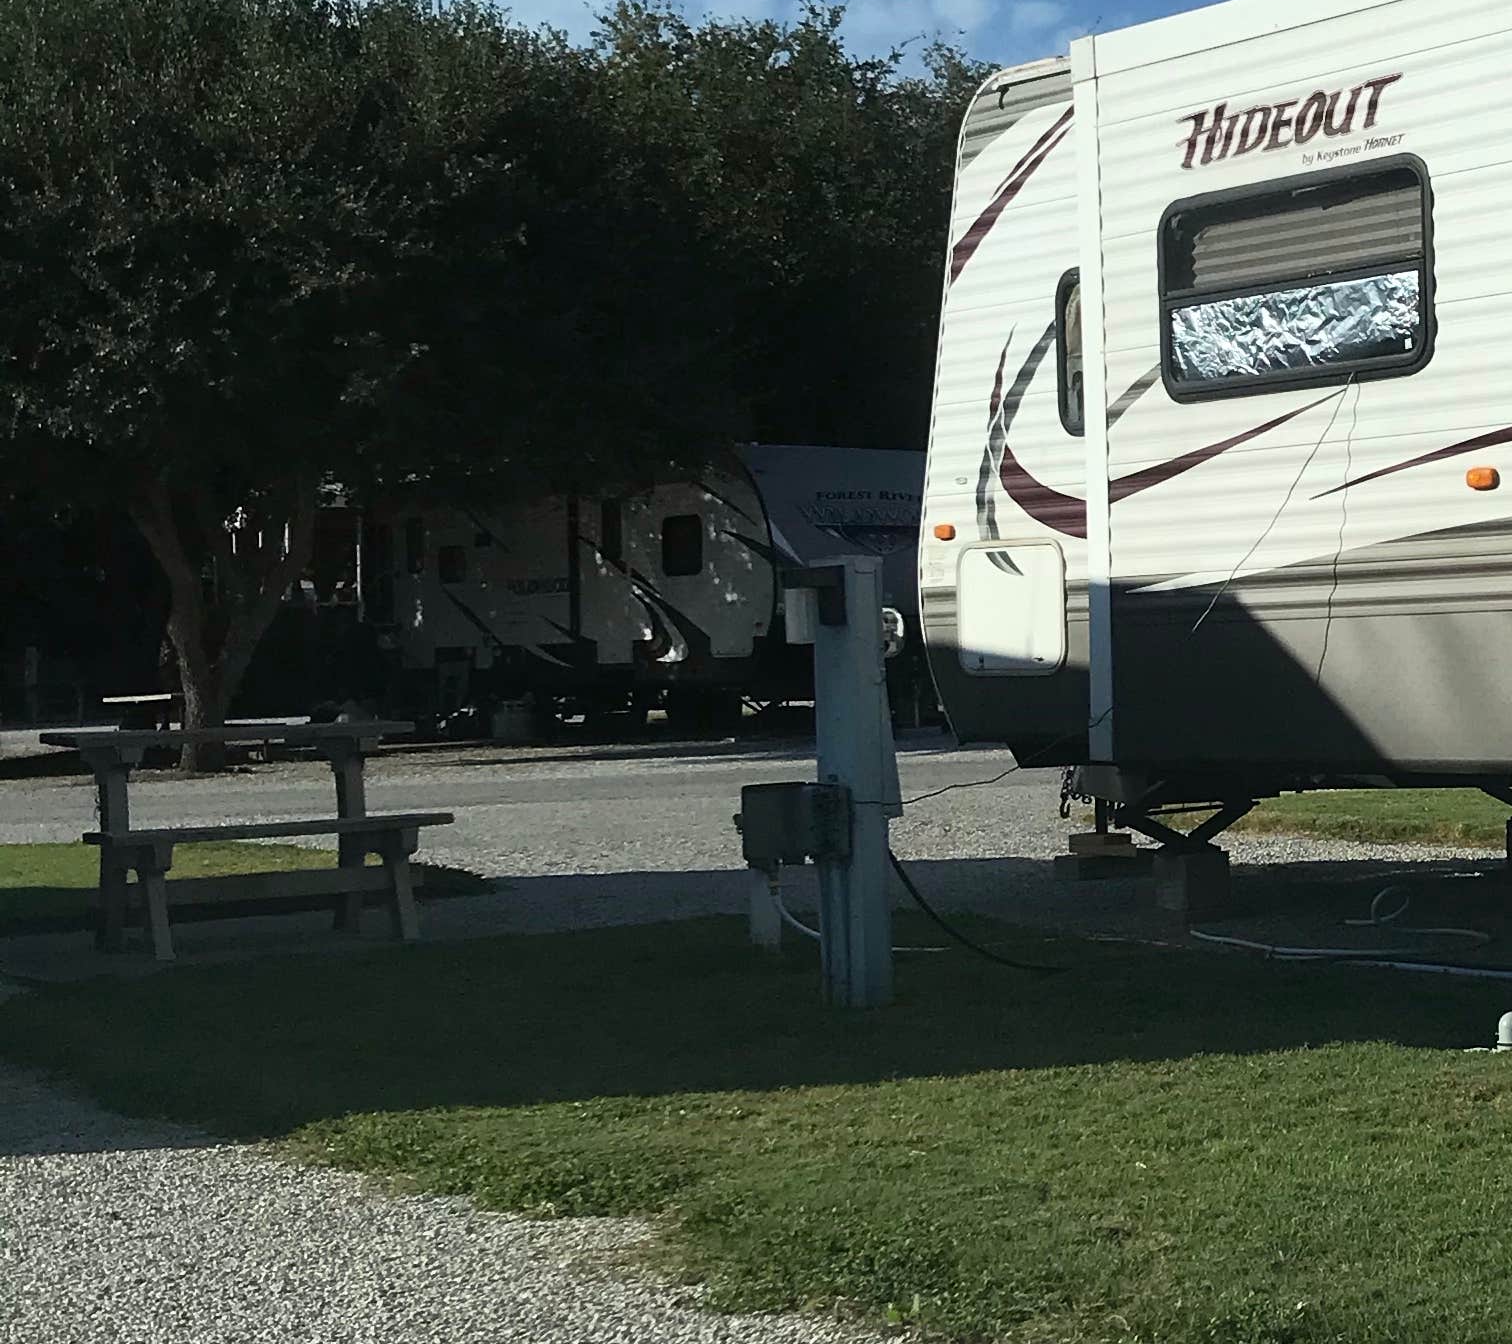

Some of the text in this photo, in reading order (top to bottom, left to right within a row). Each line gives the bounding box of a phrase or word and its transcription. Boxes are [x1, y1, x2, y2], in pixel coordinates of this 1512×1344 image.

[1176, 72, 1404, 169] HIDEOUT
[1302, 133, 1406, 166] by Keystone HORNET
[816, 490, 873, 501] FOREST
